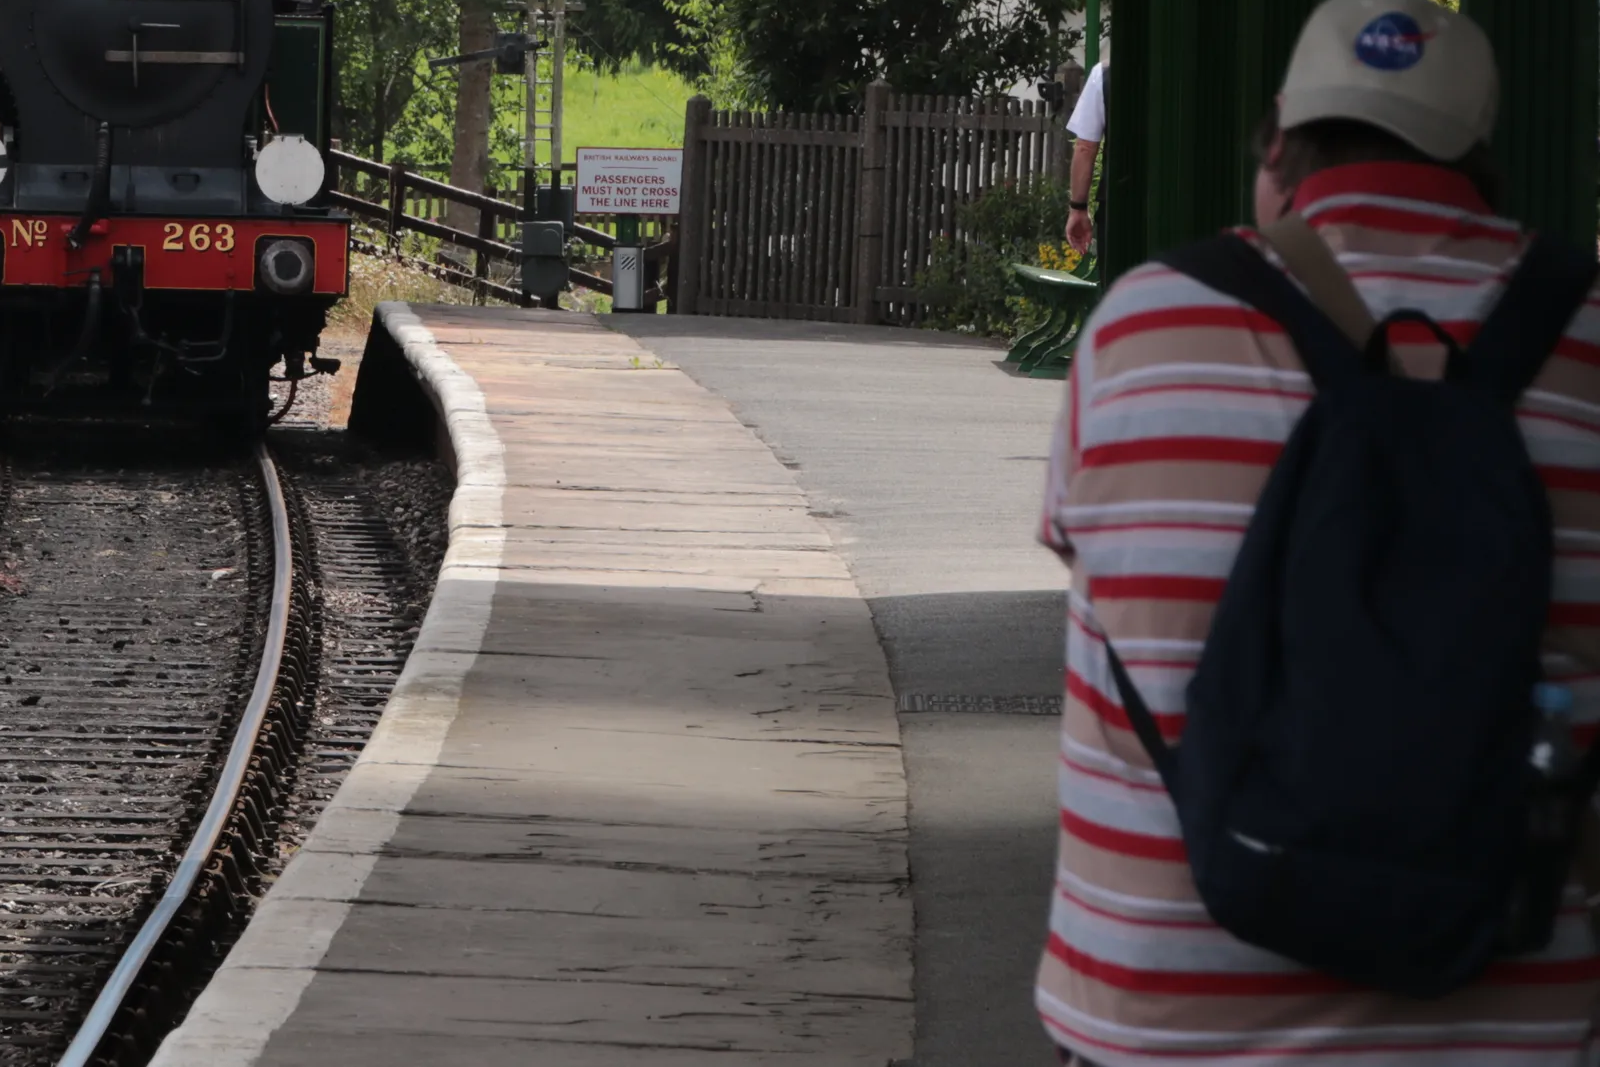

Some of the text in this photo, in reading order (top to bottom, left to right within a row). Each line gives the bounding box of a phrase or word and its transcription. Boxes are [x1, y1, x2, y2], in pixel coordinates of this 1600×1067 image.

[594, 175, 665, 184] PASSENGERS
[582, 186, 678, 196] MUST NOT CROSS
[590, 198, 670, 208] THE LINE HERE
[162, 223, 236, 252] 263
